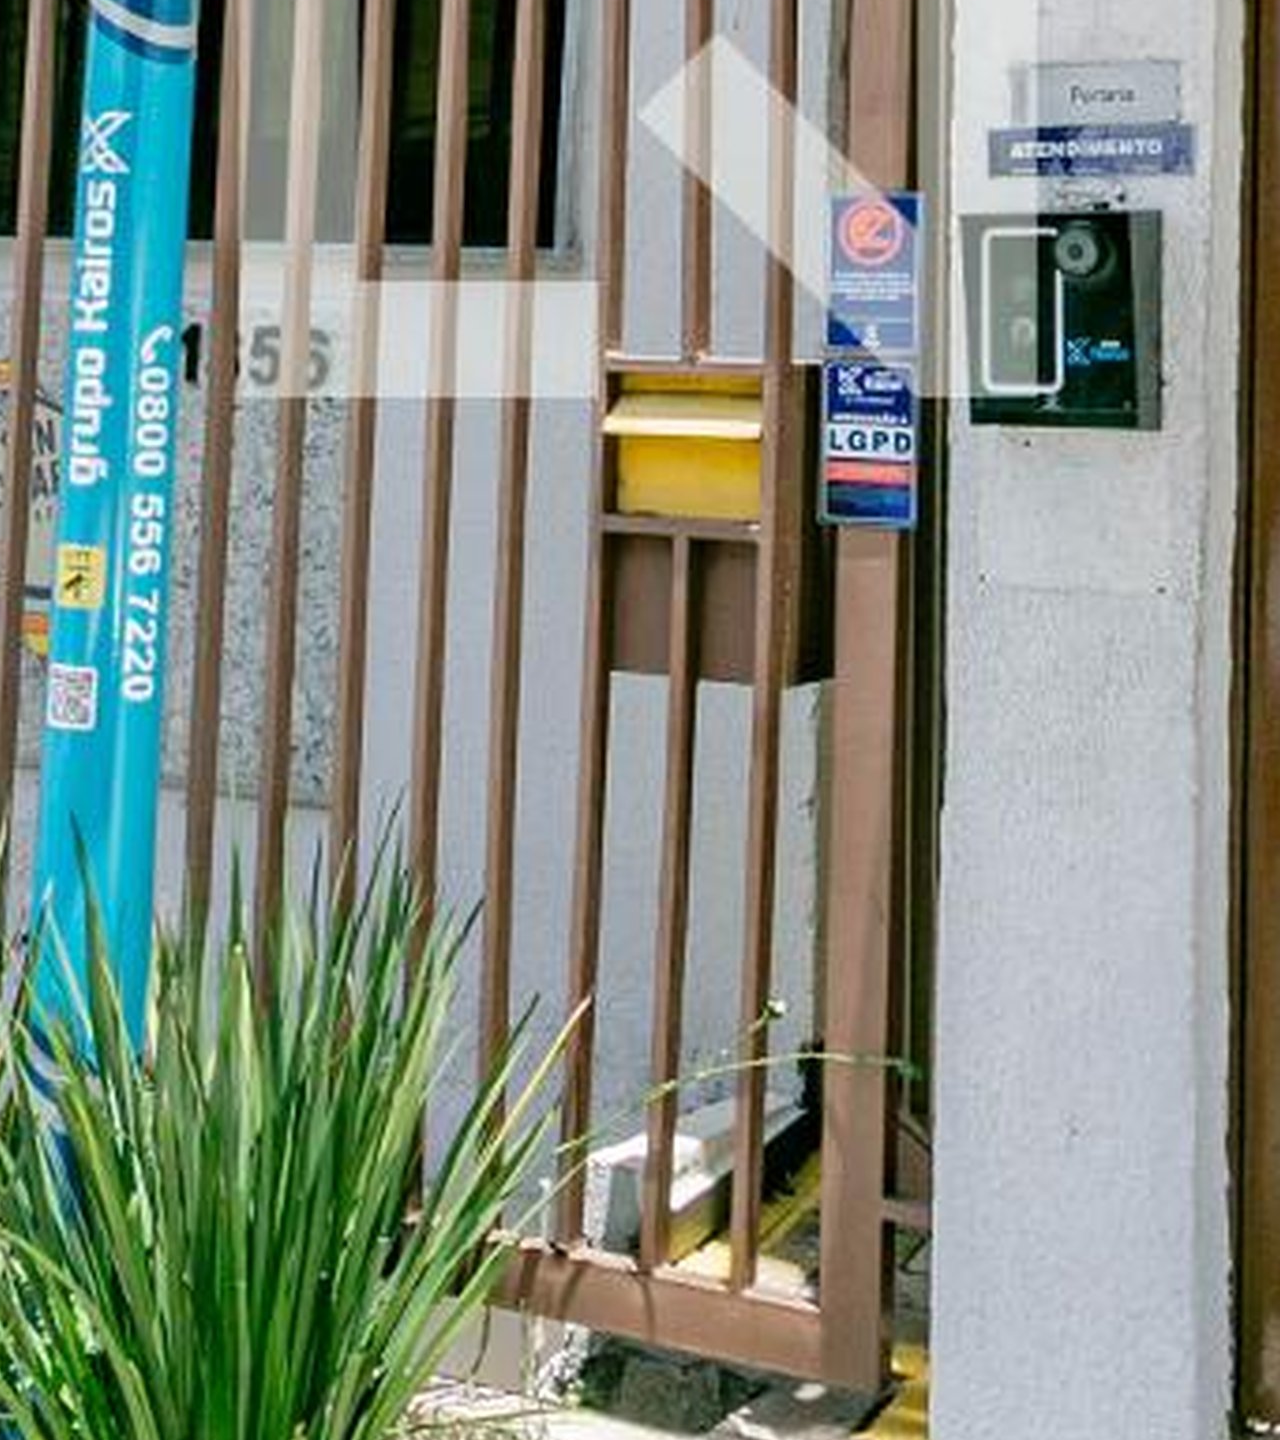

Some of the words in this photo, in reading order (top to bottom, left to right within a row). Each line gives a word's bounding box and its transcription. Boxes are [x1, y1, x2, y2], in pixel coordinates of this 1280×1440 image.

[1009, 137, 1164, 159] ATENDIMENTO
[73, 179, 117, 332] Kairos
[69, 347, 113, 486] grupo
[133, 366, 171, 478] 0800
[829, 429, 912, 454] LGPD
[128, 493, 165, 575] 556
[122, 590, 159, 703] 7220
